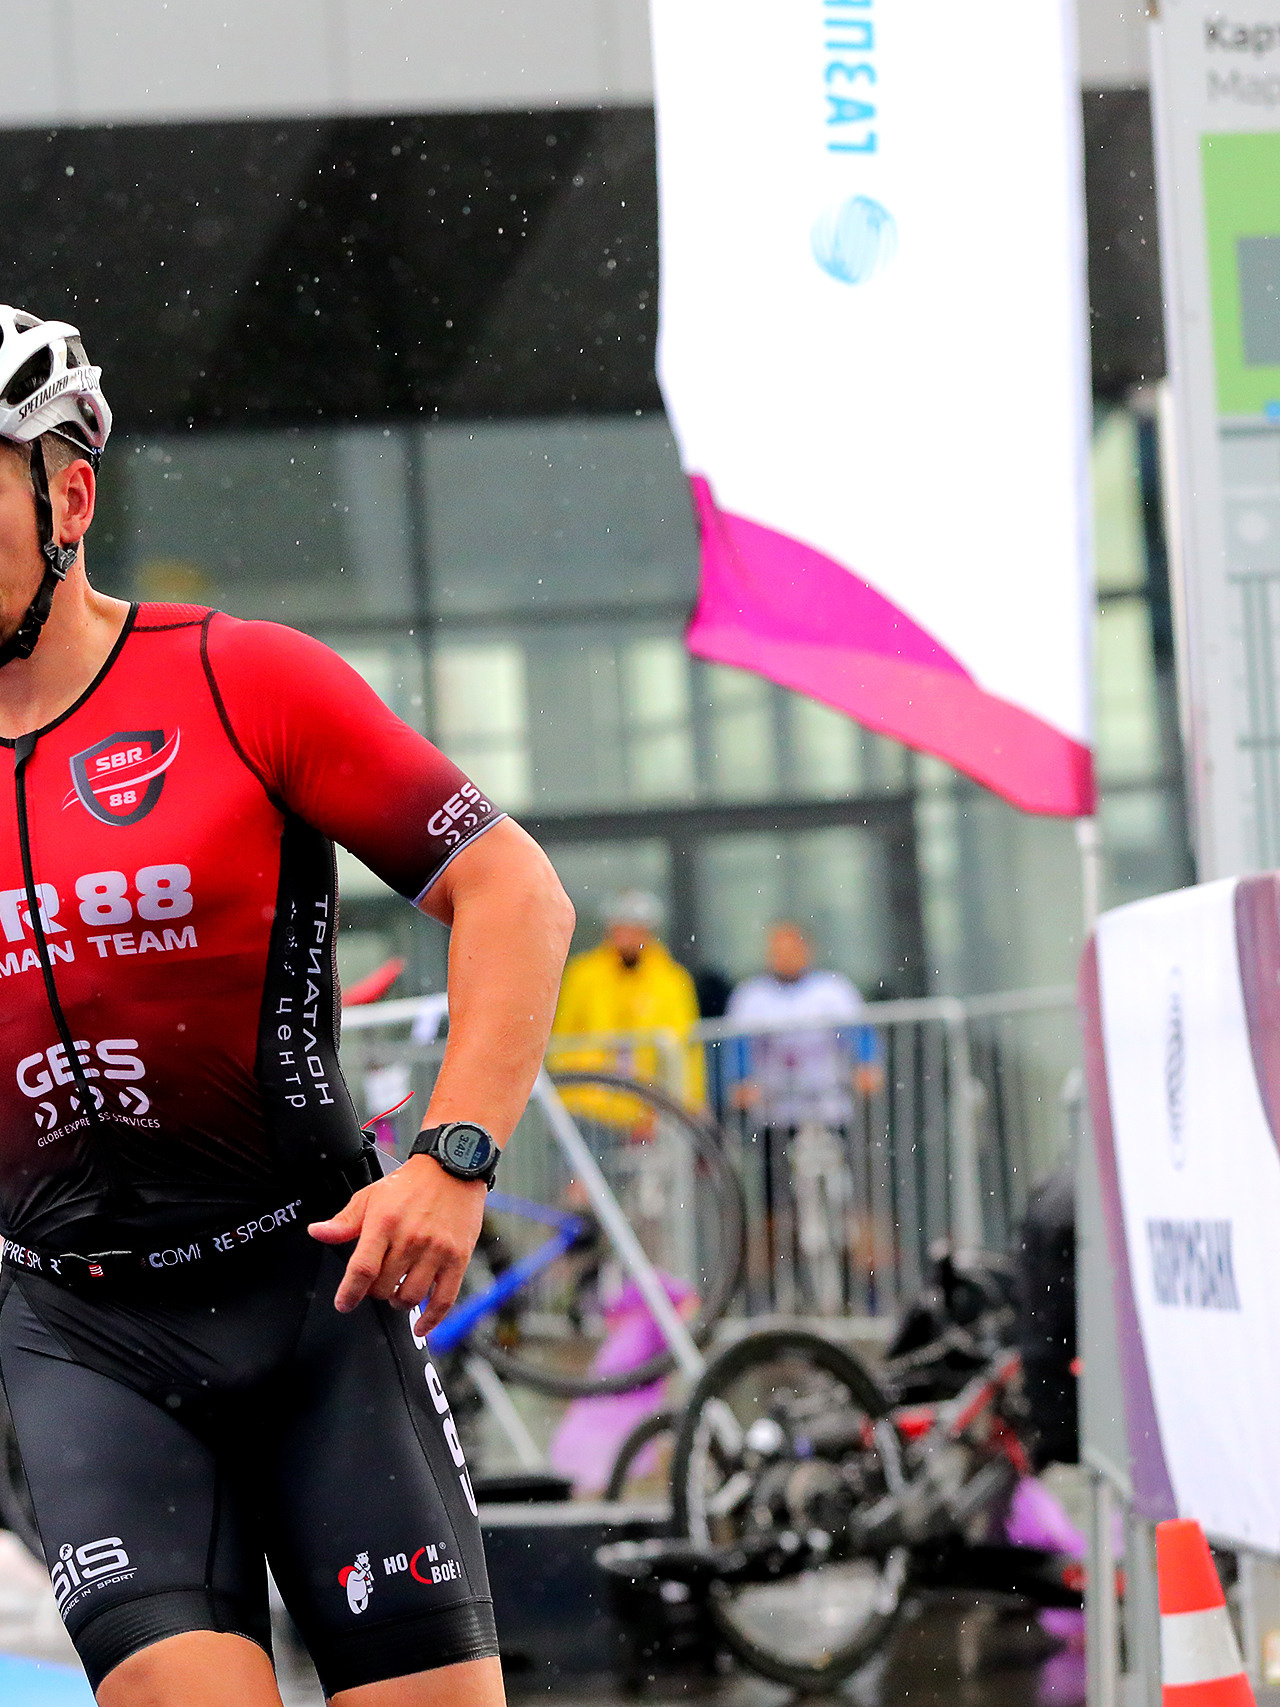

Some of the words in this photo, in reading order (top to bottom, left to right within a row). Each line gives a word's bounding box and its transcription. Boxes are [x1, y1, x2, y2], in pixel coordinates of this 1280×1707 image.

[19, 375, 69, 420] SPECIALIZED
[95, 747, 143, 772] SBR
[109, 790, 137, 807] 88
[427, 782, 481, 836] GES
[75, 863, 194, 927] 88
[87, 925, 198, 958] TEAM
[302, 894, 335, 1106] ТРИАТЛОН
[16, 1038, 147, 1098] GES
[275, 997, 307, 1108] центр
[37, 1128, 65, 1147] GLOBE
[81, 1588, 92, 1598] IN
[97, 1572, 135, 1590] SPORT
